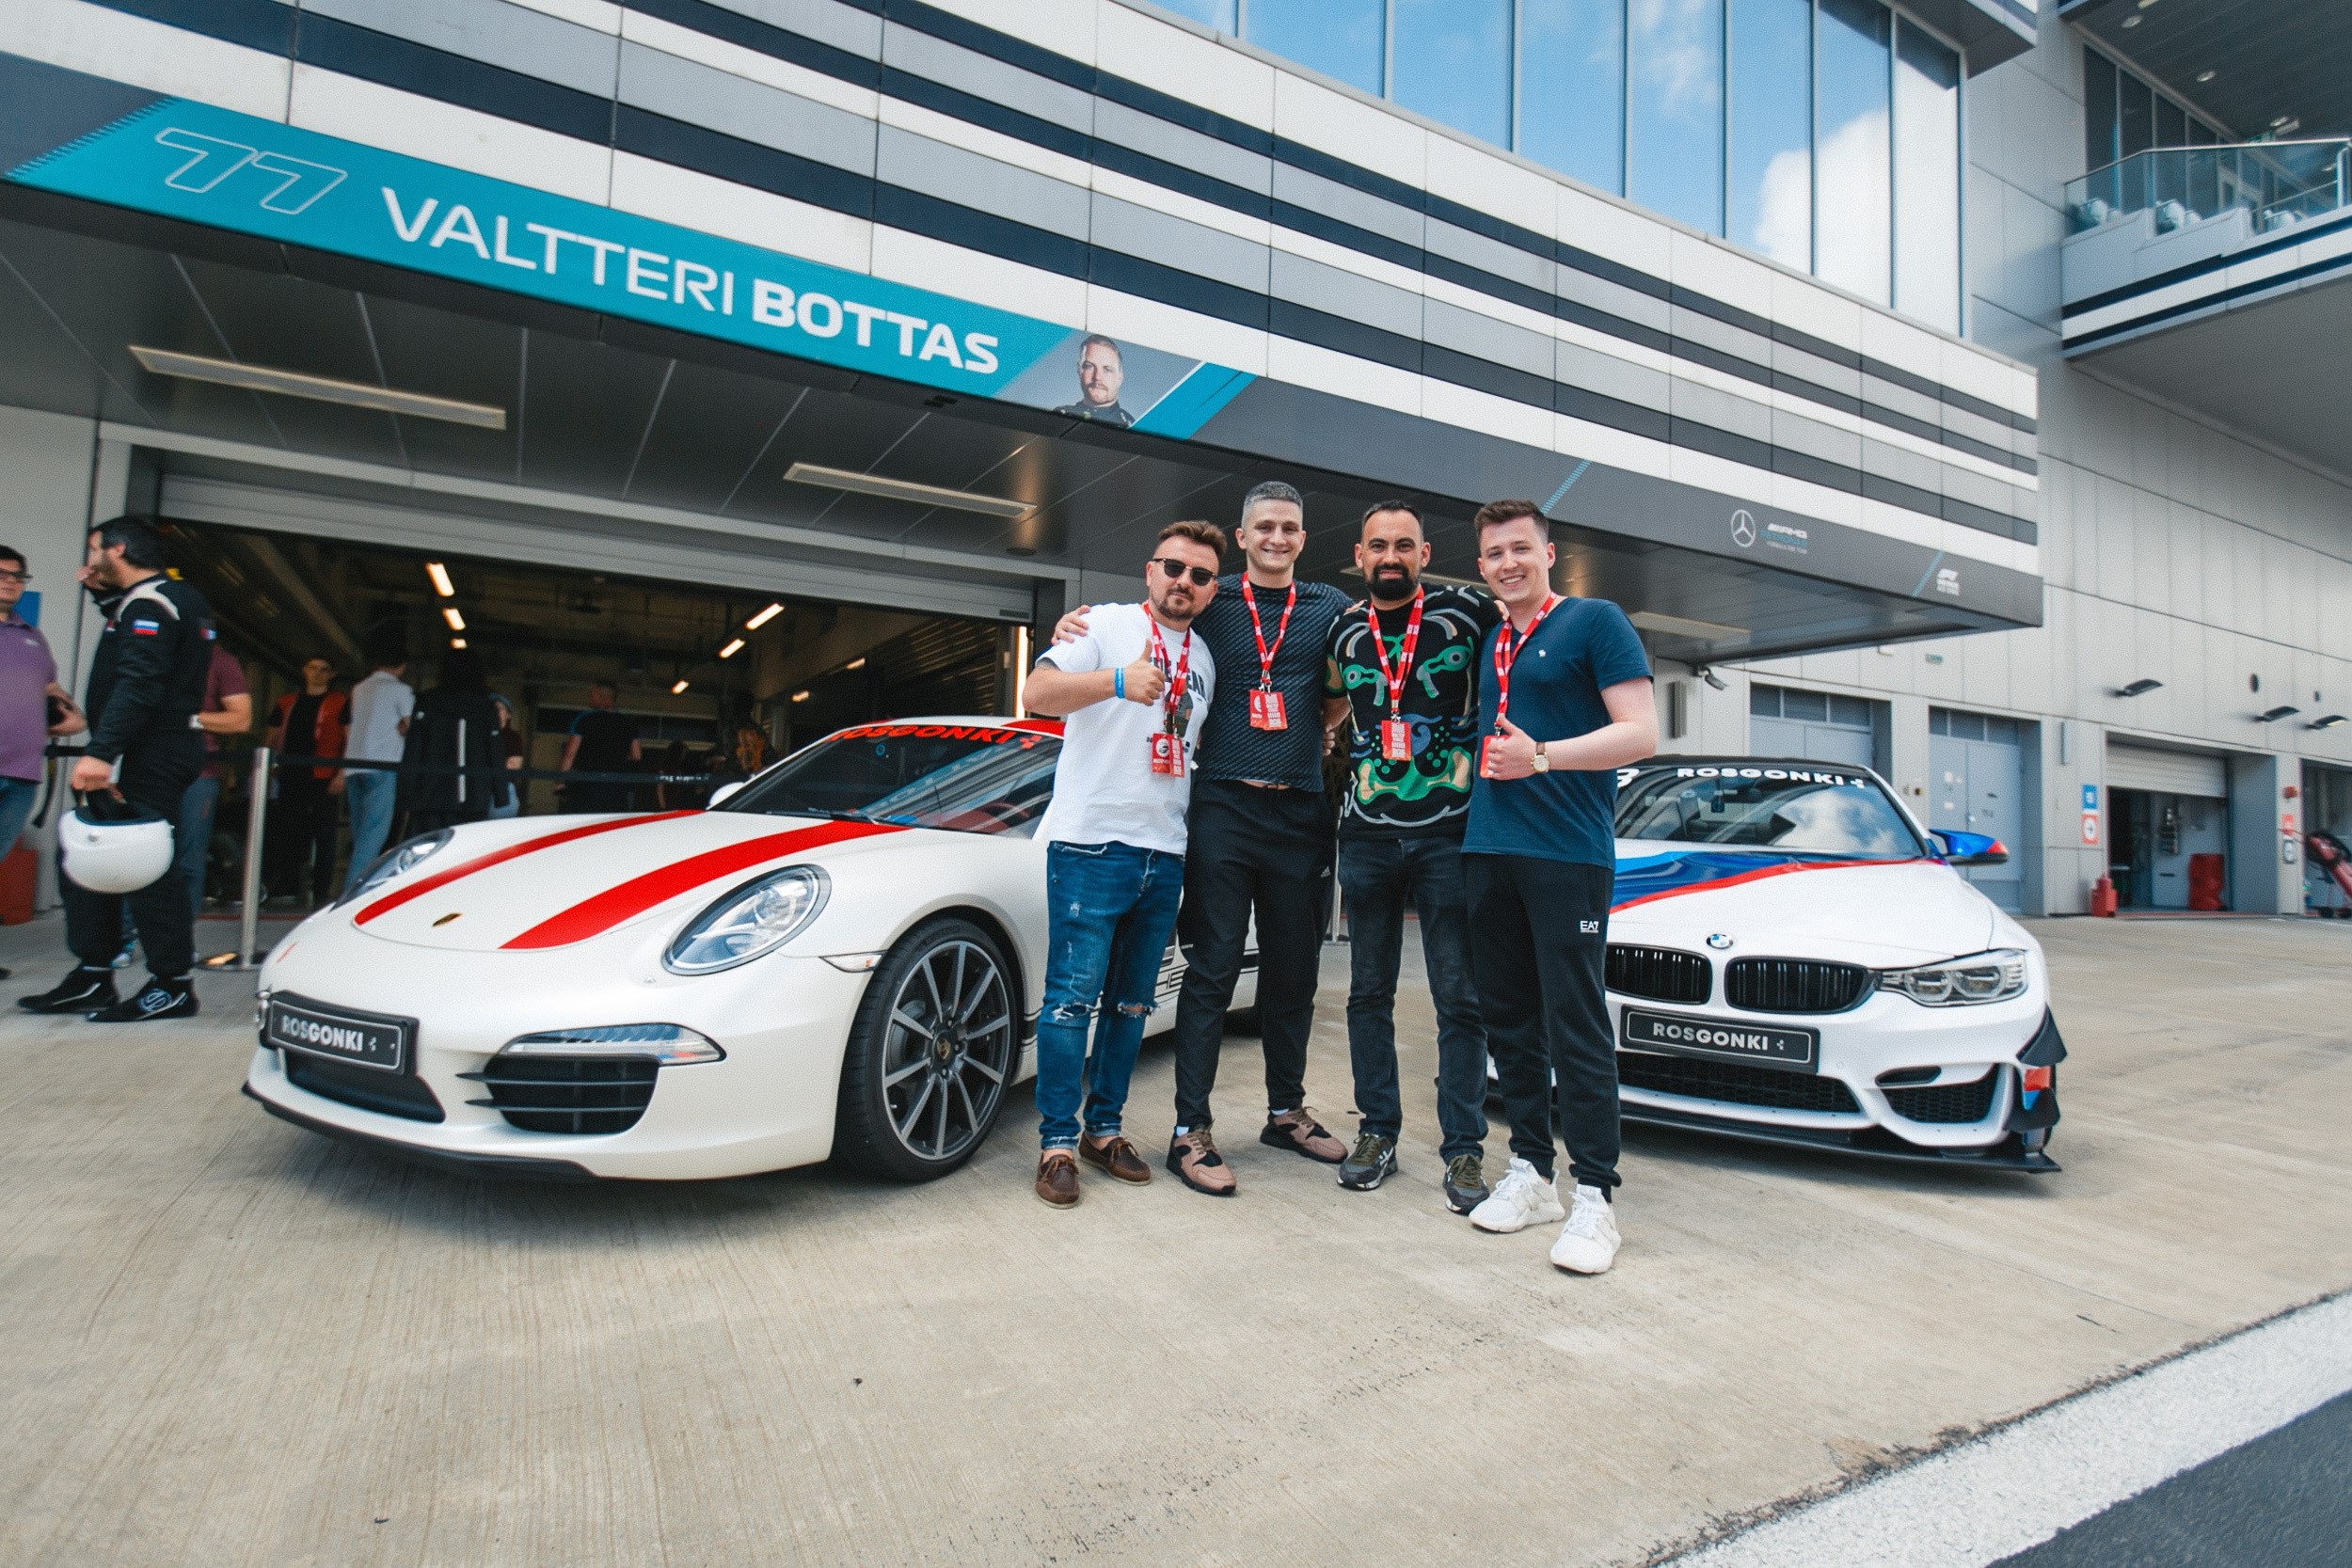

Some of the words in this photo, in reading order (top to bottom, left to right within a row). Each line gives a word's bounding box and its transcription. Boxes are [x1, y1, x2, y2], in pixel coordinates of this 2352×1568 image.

[154, 127, 348, 214] 77
[381, 186, 734, 315] VALTTERI
[752, 277, 999, 374] BOTTAS
[1677, 768, 1845, 785] ROSGONKI
[1581, 920, 1599, 930] EA7
[280, 1014, 364, 1053] ROSGONKI
[1652, 1022, 1769, 1051] ROSGONKI
